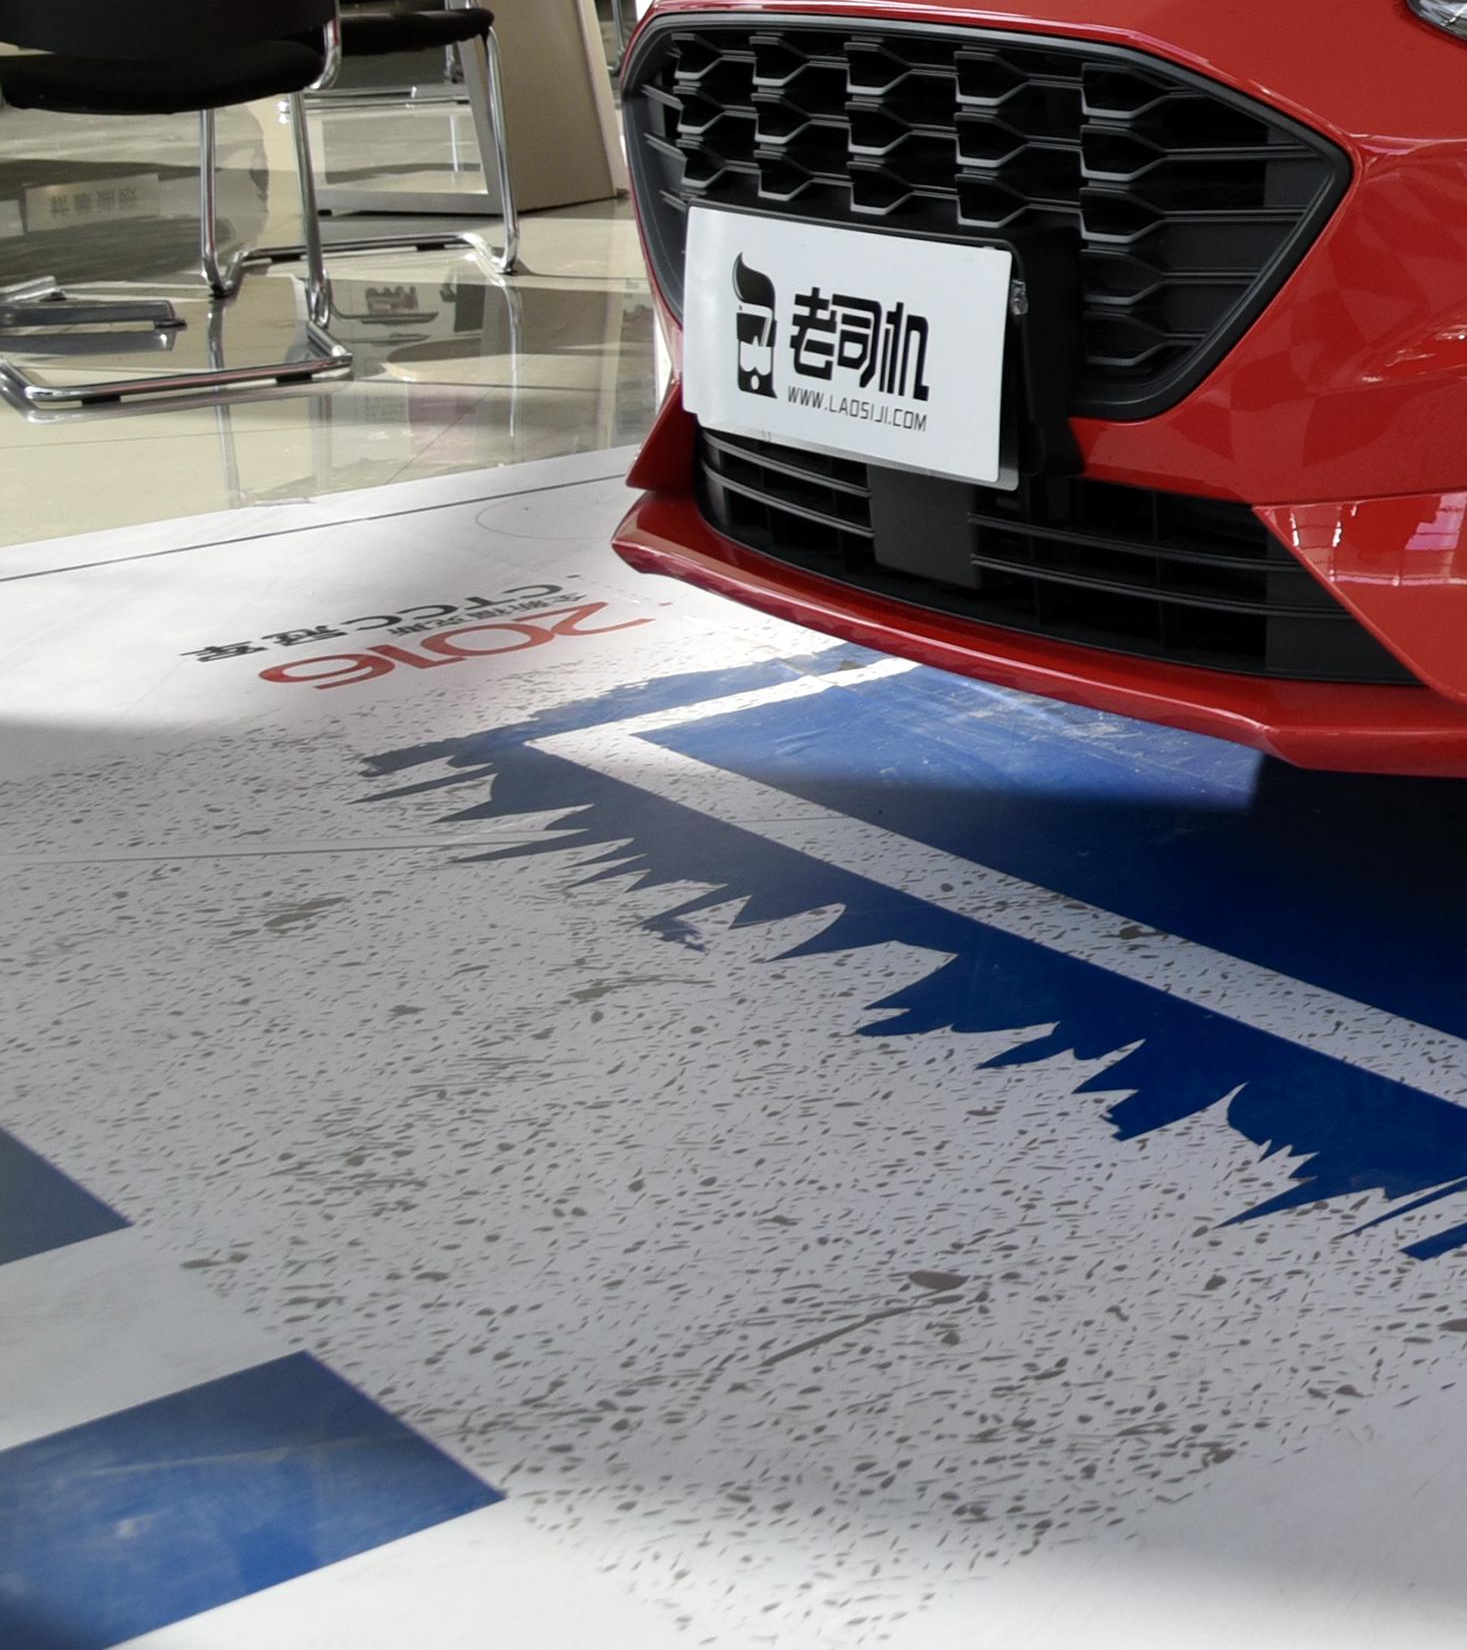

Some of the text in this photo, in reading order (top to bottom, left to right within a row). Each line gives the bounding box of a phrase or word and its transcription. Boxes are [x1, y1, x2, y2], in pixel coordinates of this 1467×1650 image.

[789, 286, 930, 402] 老司机
[786, 385, 928, 432] WWW.LAOSIJI.COM
[180, 583, 563, 663] CTCC冠军
[257, 601, 656, 690] 2016
